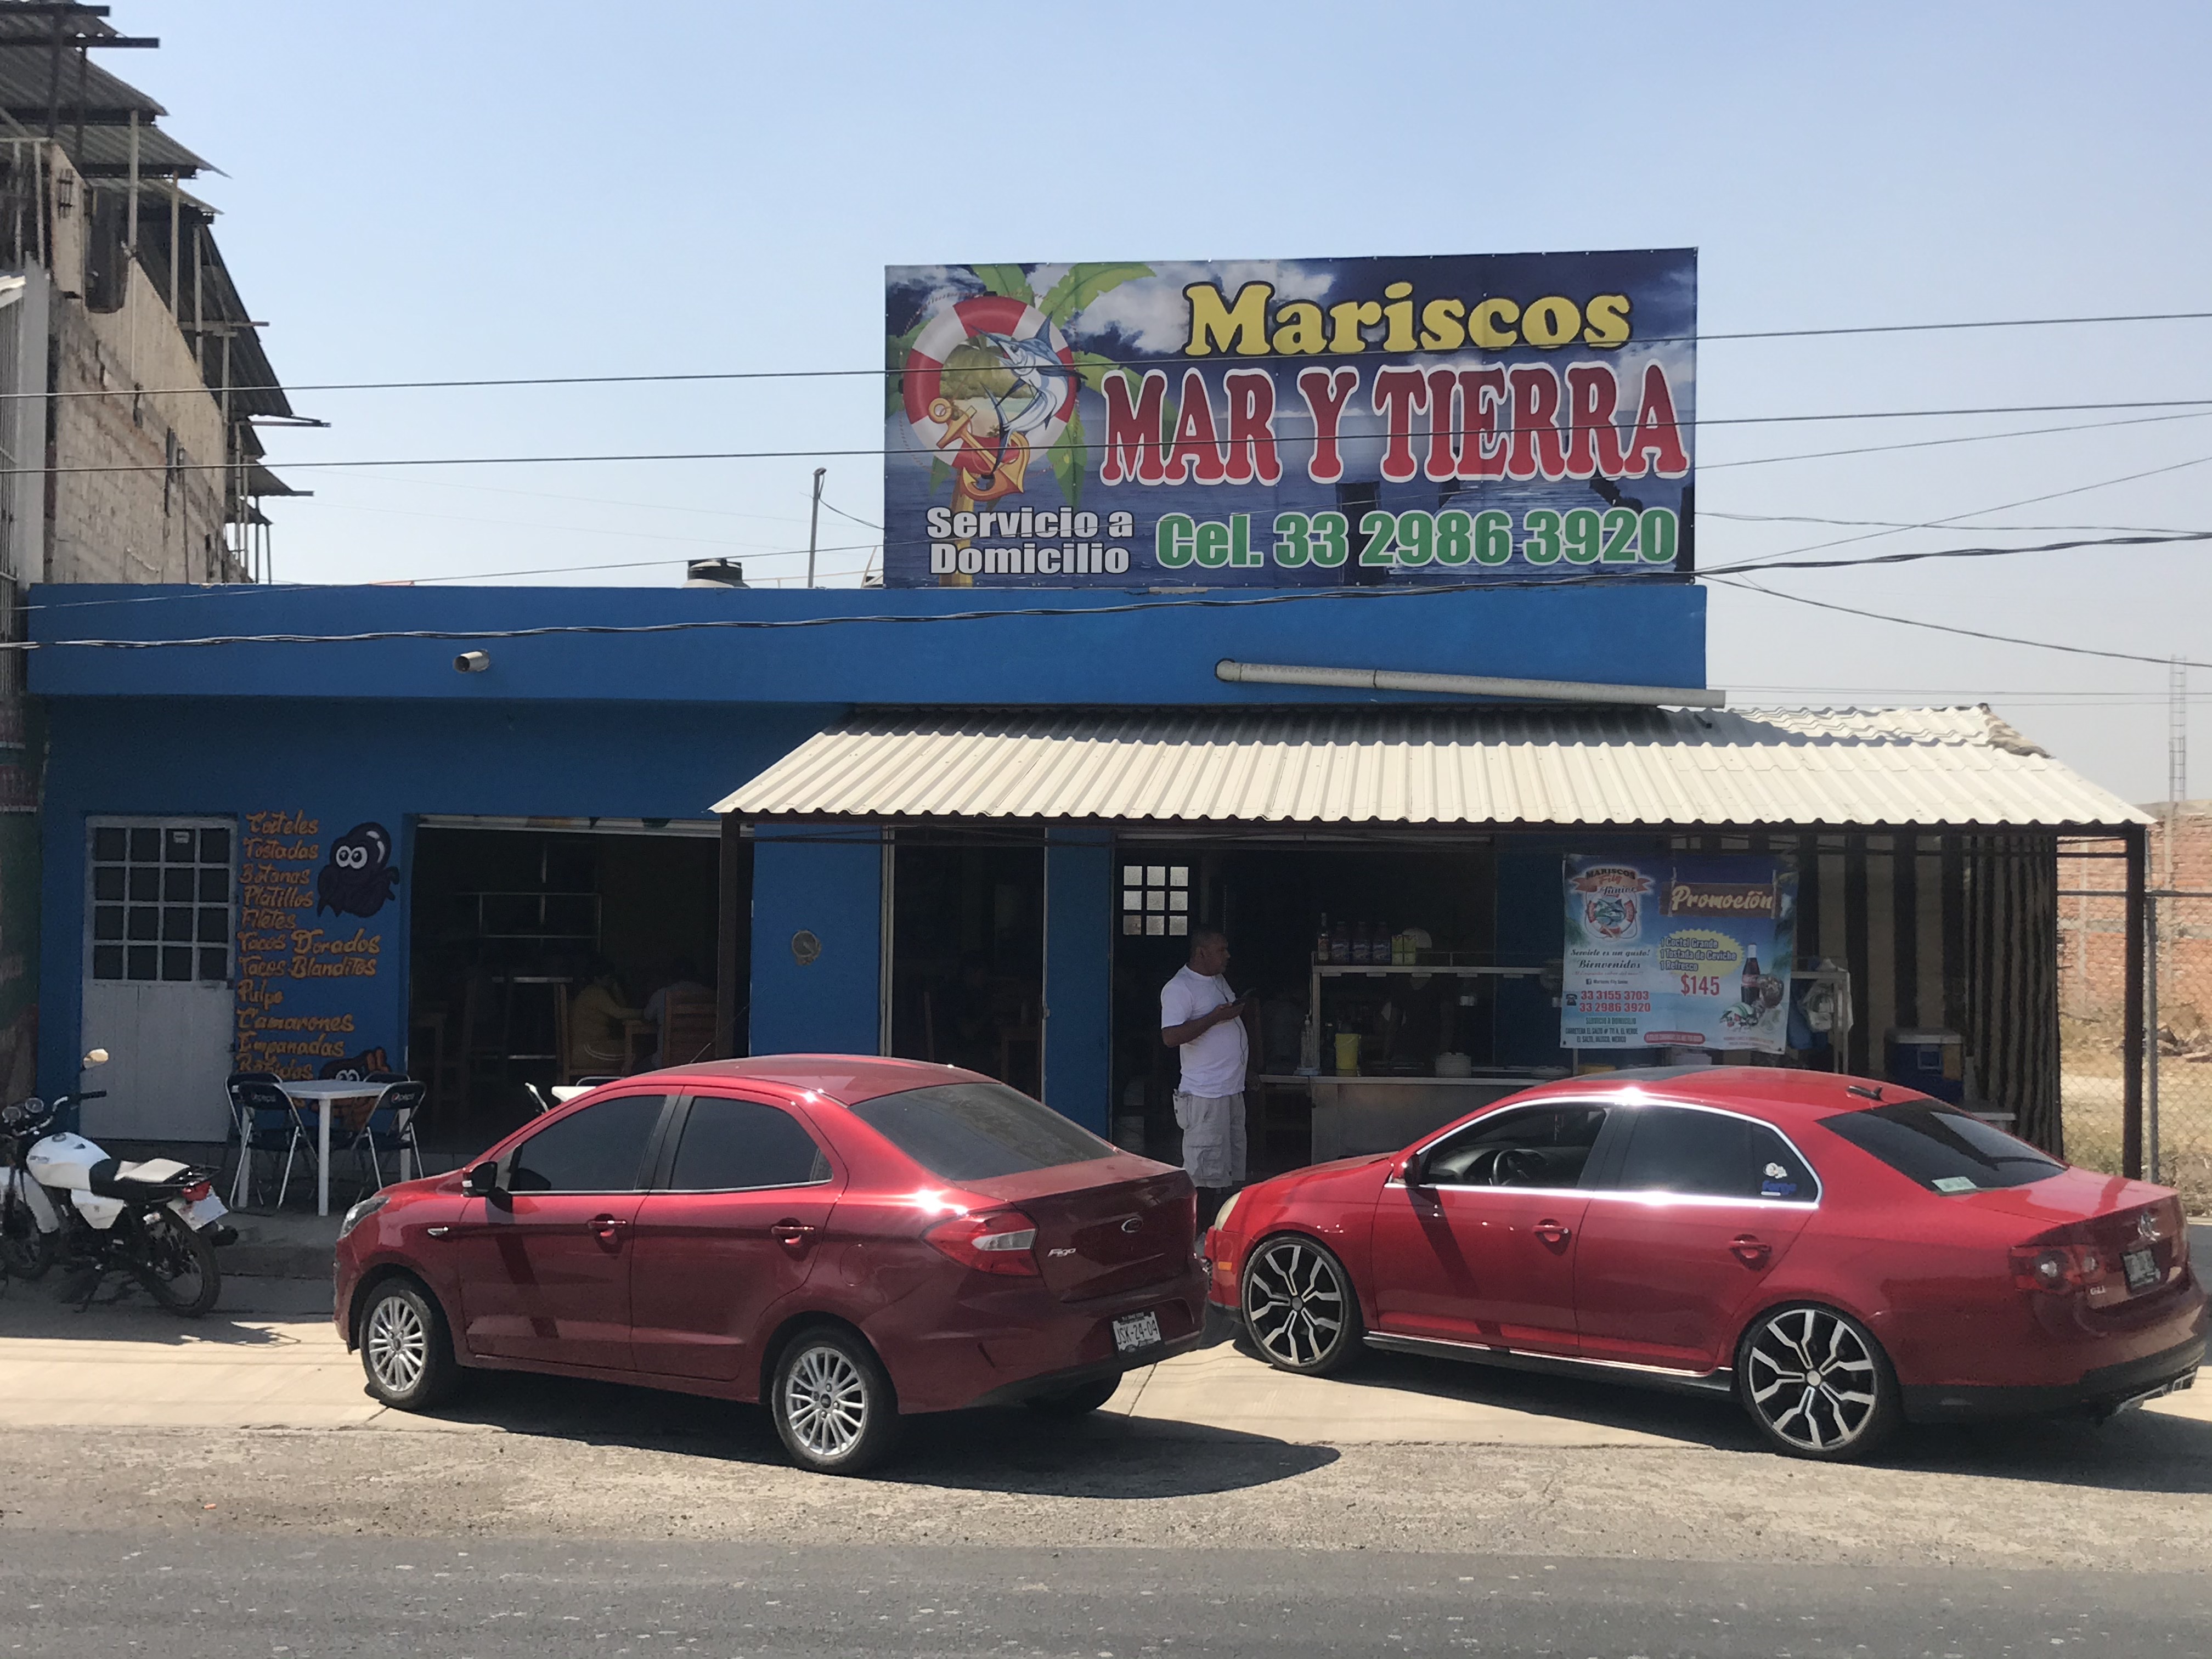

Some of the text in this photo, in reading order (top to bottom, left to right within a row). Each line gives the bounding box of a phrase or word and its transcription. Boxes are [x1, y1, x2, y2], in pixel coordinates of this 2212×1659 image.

[1183, 282, 1632, 356] Mariscos
[1100, 360, 1691, 487] MAR Y TIERRA
[926, 506, 1134, 539] Servicio a
[1156, 506, 1679, 568] Cel. 33 2986 3920
[930, 541, 1130, 575] Domicilio
[243, 837, 319, 860] Tostadas
[239, 863, 311, 885] Botanas
[1586, 868, 1636, 879] MARISCOS
[244, 884, 314, 908] Platillos
[241, 907, 296, 930] Filetes
[238, 928, 381, 955] Tacos Dorados
[1660, 937, 1719, 949] 1 Coctel Grande
[238, 955, 377, 979] Tacos Blanditos
[1577, 960, 1640, 969] Bienvenidos
[1660, 949, 1737, 961] 1 Tostada de Ceviche
[1660, 960, 1699, 972] 1 Refresco
[237, 979, 284, 1011] Pulpo
[1581, 990, 1649, 1000] 33 3155 3703
[1680, 972, 1720, 996] $145
[1579, 1002, 1651, 1012] 33 2986 3920
[236, 1007, 355, 1032] Camarones
[238, 1030, 345, 1060] Empanadas
[1047, 1248, 1076, 1258] Figo
[1117, 1319, 1158, 1345] JSK-24-04
